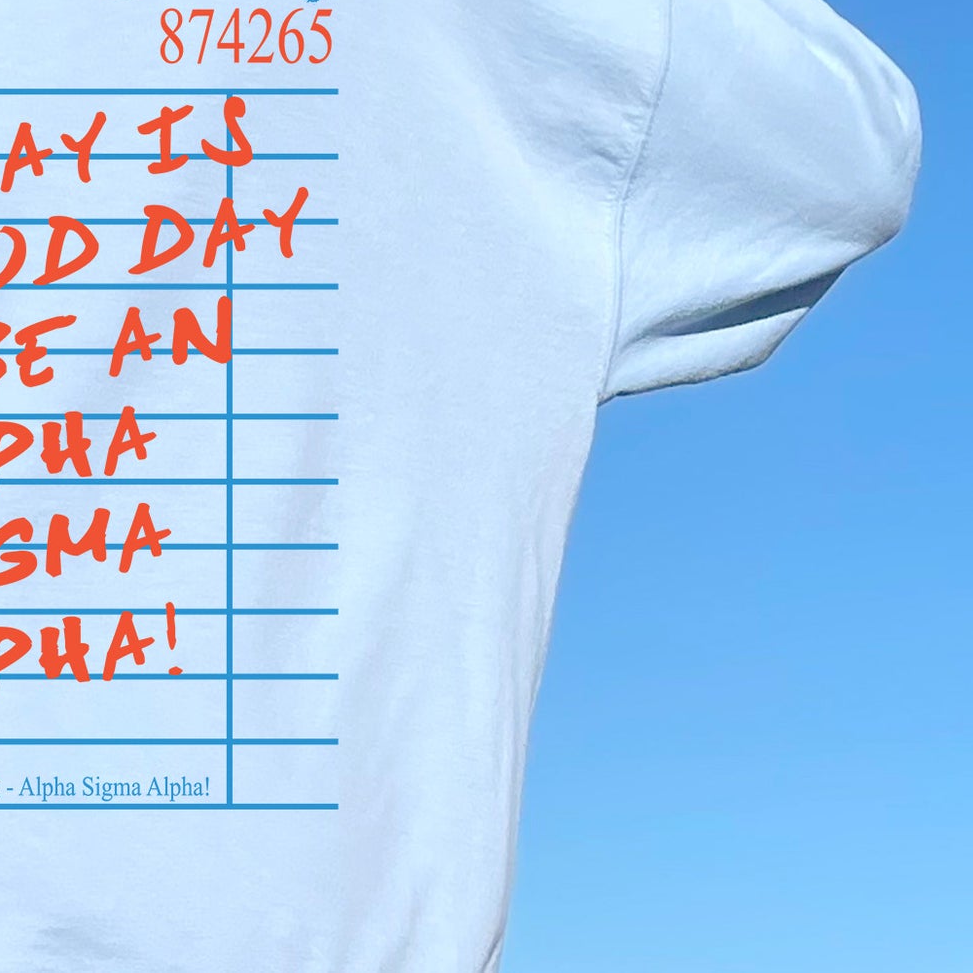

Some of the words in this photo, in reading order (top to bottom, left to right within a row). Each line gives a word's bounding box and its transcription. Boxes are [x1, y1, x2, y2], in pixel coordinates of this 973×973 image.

[159, 7, 333, 65] 874265
[136, 95, 254, 175] IS
[128, 186, 310, 276] DAY
[108, 295, 233, 378] AN
[18, 774, 77, 803] Alpha
[81, 775, 143, 803] Sigma
[146, 774, 211, 803] Alpha!
